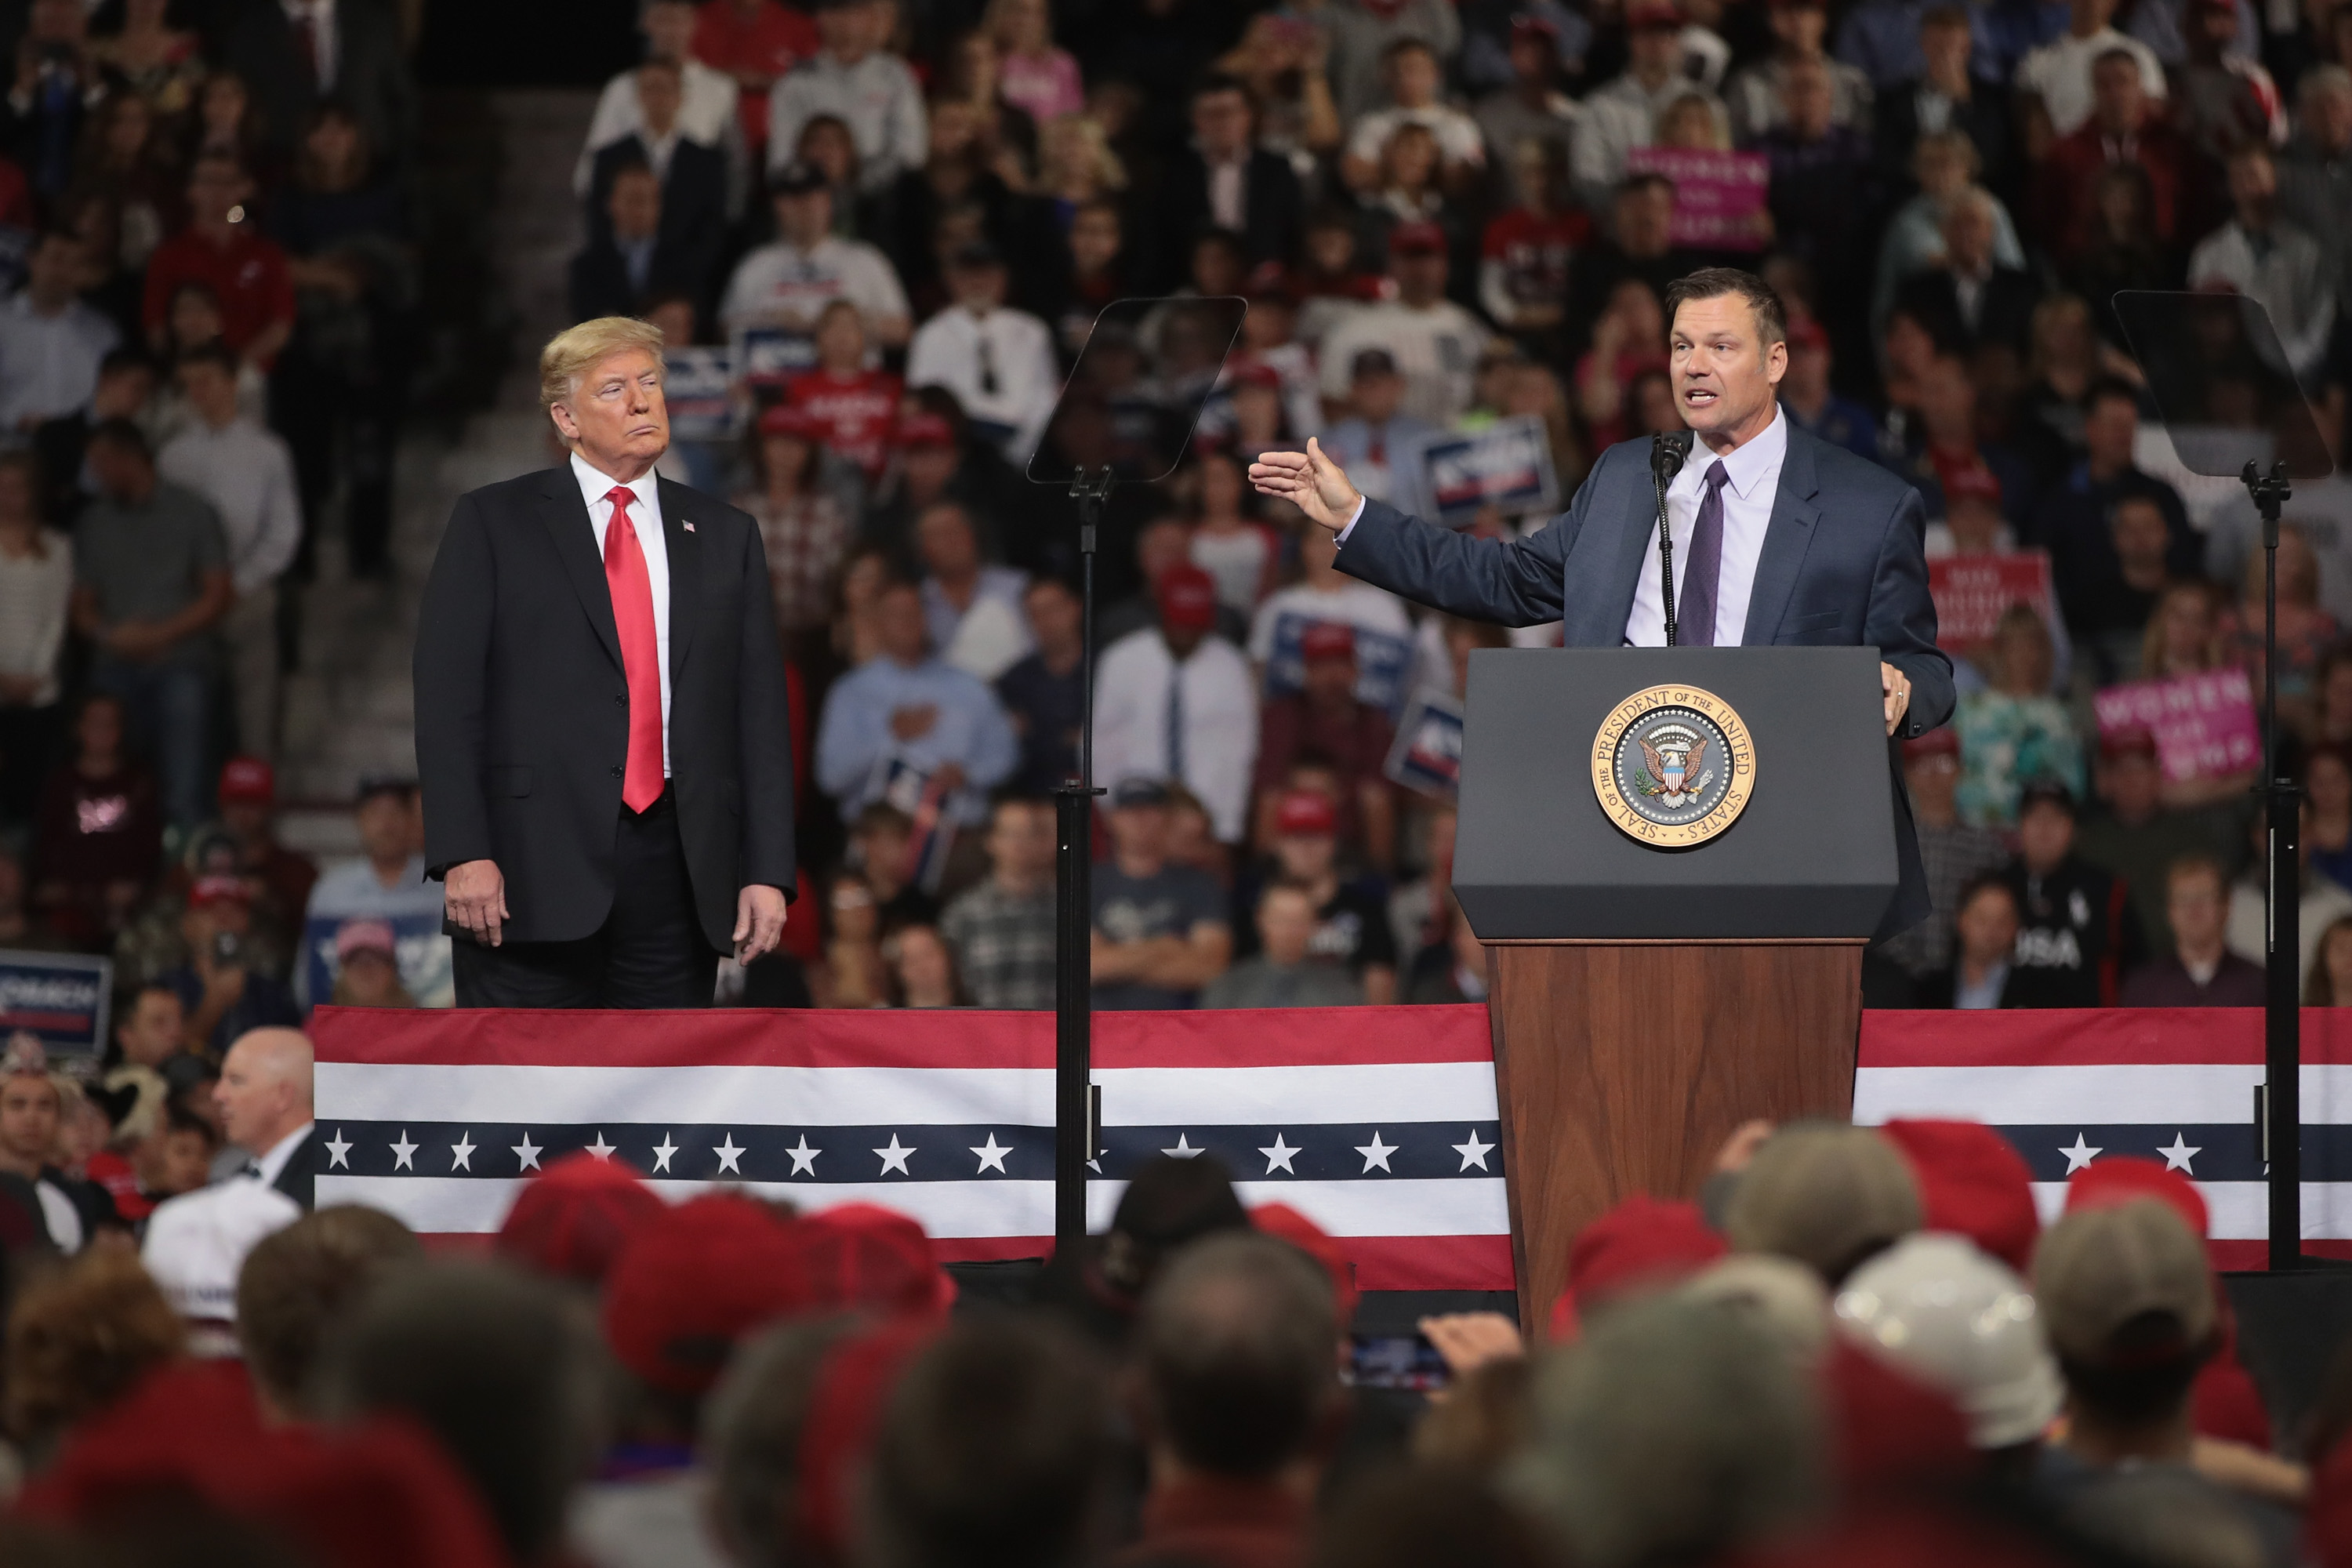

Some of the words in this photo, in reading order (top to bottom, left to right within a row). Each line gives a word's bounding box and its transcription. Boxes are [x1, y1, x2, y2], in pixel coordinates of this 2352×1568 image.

[1675, 692, 1690, 702] OF
[1693, 695, 1713, 711] THE
[1597, 690, 1670, 762] PRESIDENT
[1716, 710, 1750, 775] UNITED
[1599, 767, 1611, 790] THE
[1605, 793, 1618, 807] OF
[1687, 789, 1743, 839] STATES
[1617, 804, 1658, 839] SEAL
